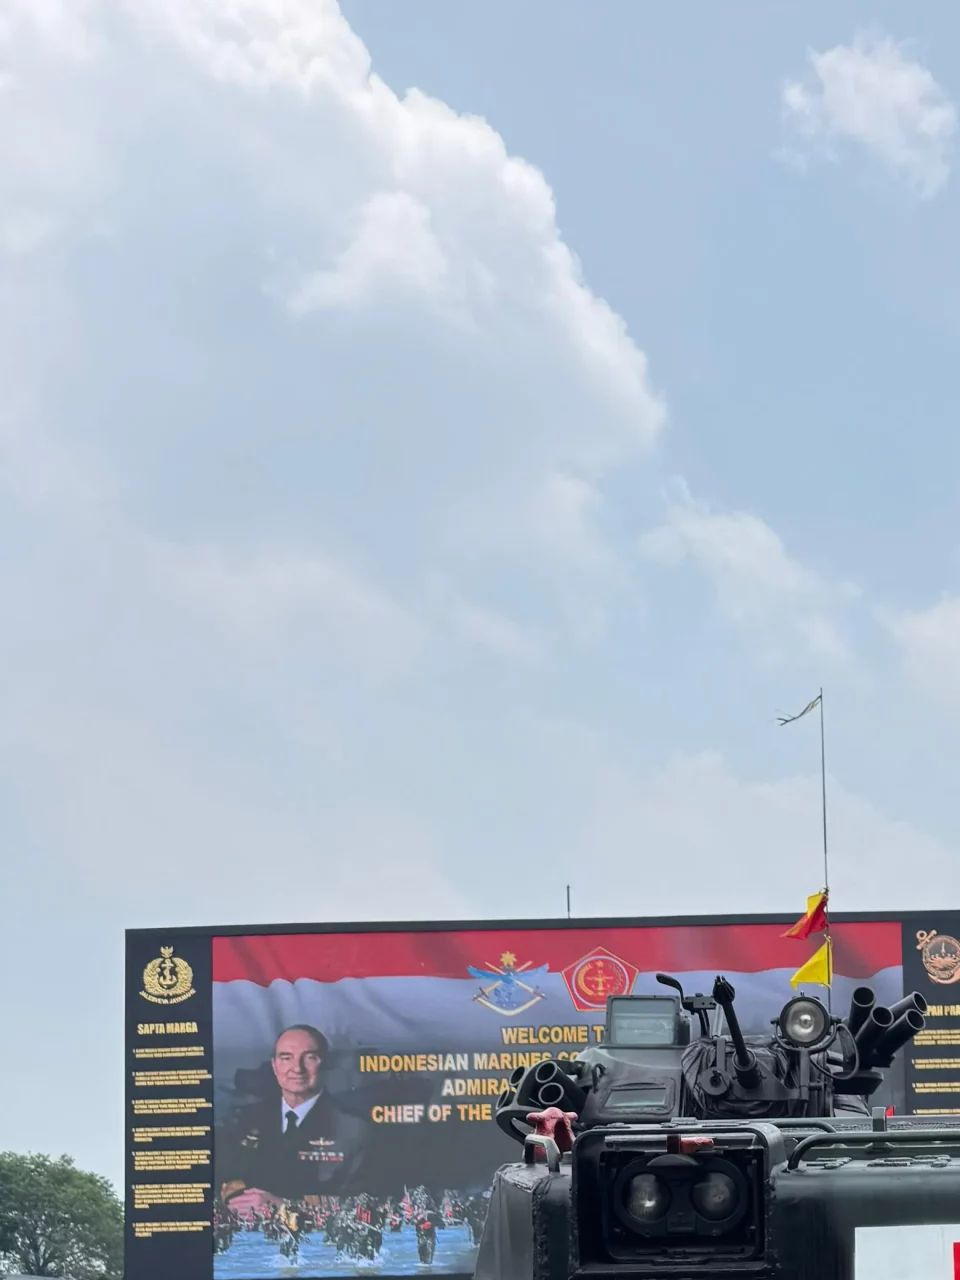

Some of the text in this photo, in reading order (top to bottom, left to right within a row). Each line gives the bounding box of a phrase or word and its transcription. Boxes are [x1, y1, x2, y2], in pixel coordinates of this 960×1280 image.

[137, 1022, 198, 1035] SAPTA MARGA
[502, 1025, 605, 1044] WELCOME T
[360, 1053, 469, 1072] INDONESIAN
[441, 1078, 517, 1096] ADMIRA
[371, 1103, 492, 1123] CHIEF OF THE
